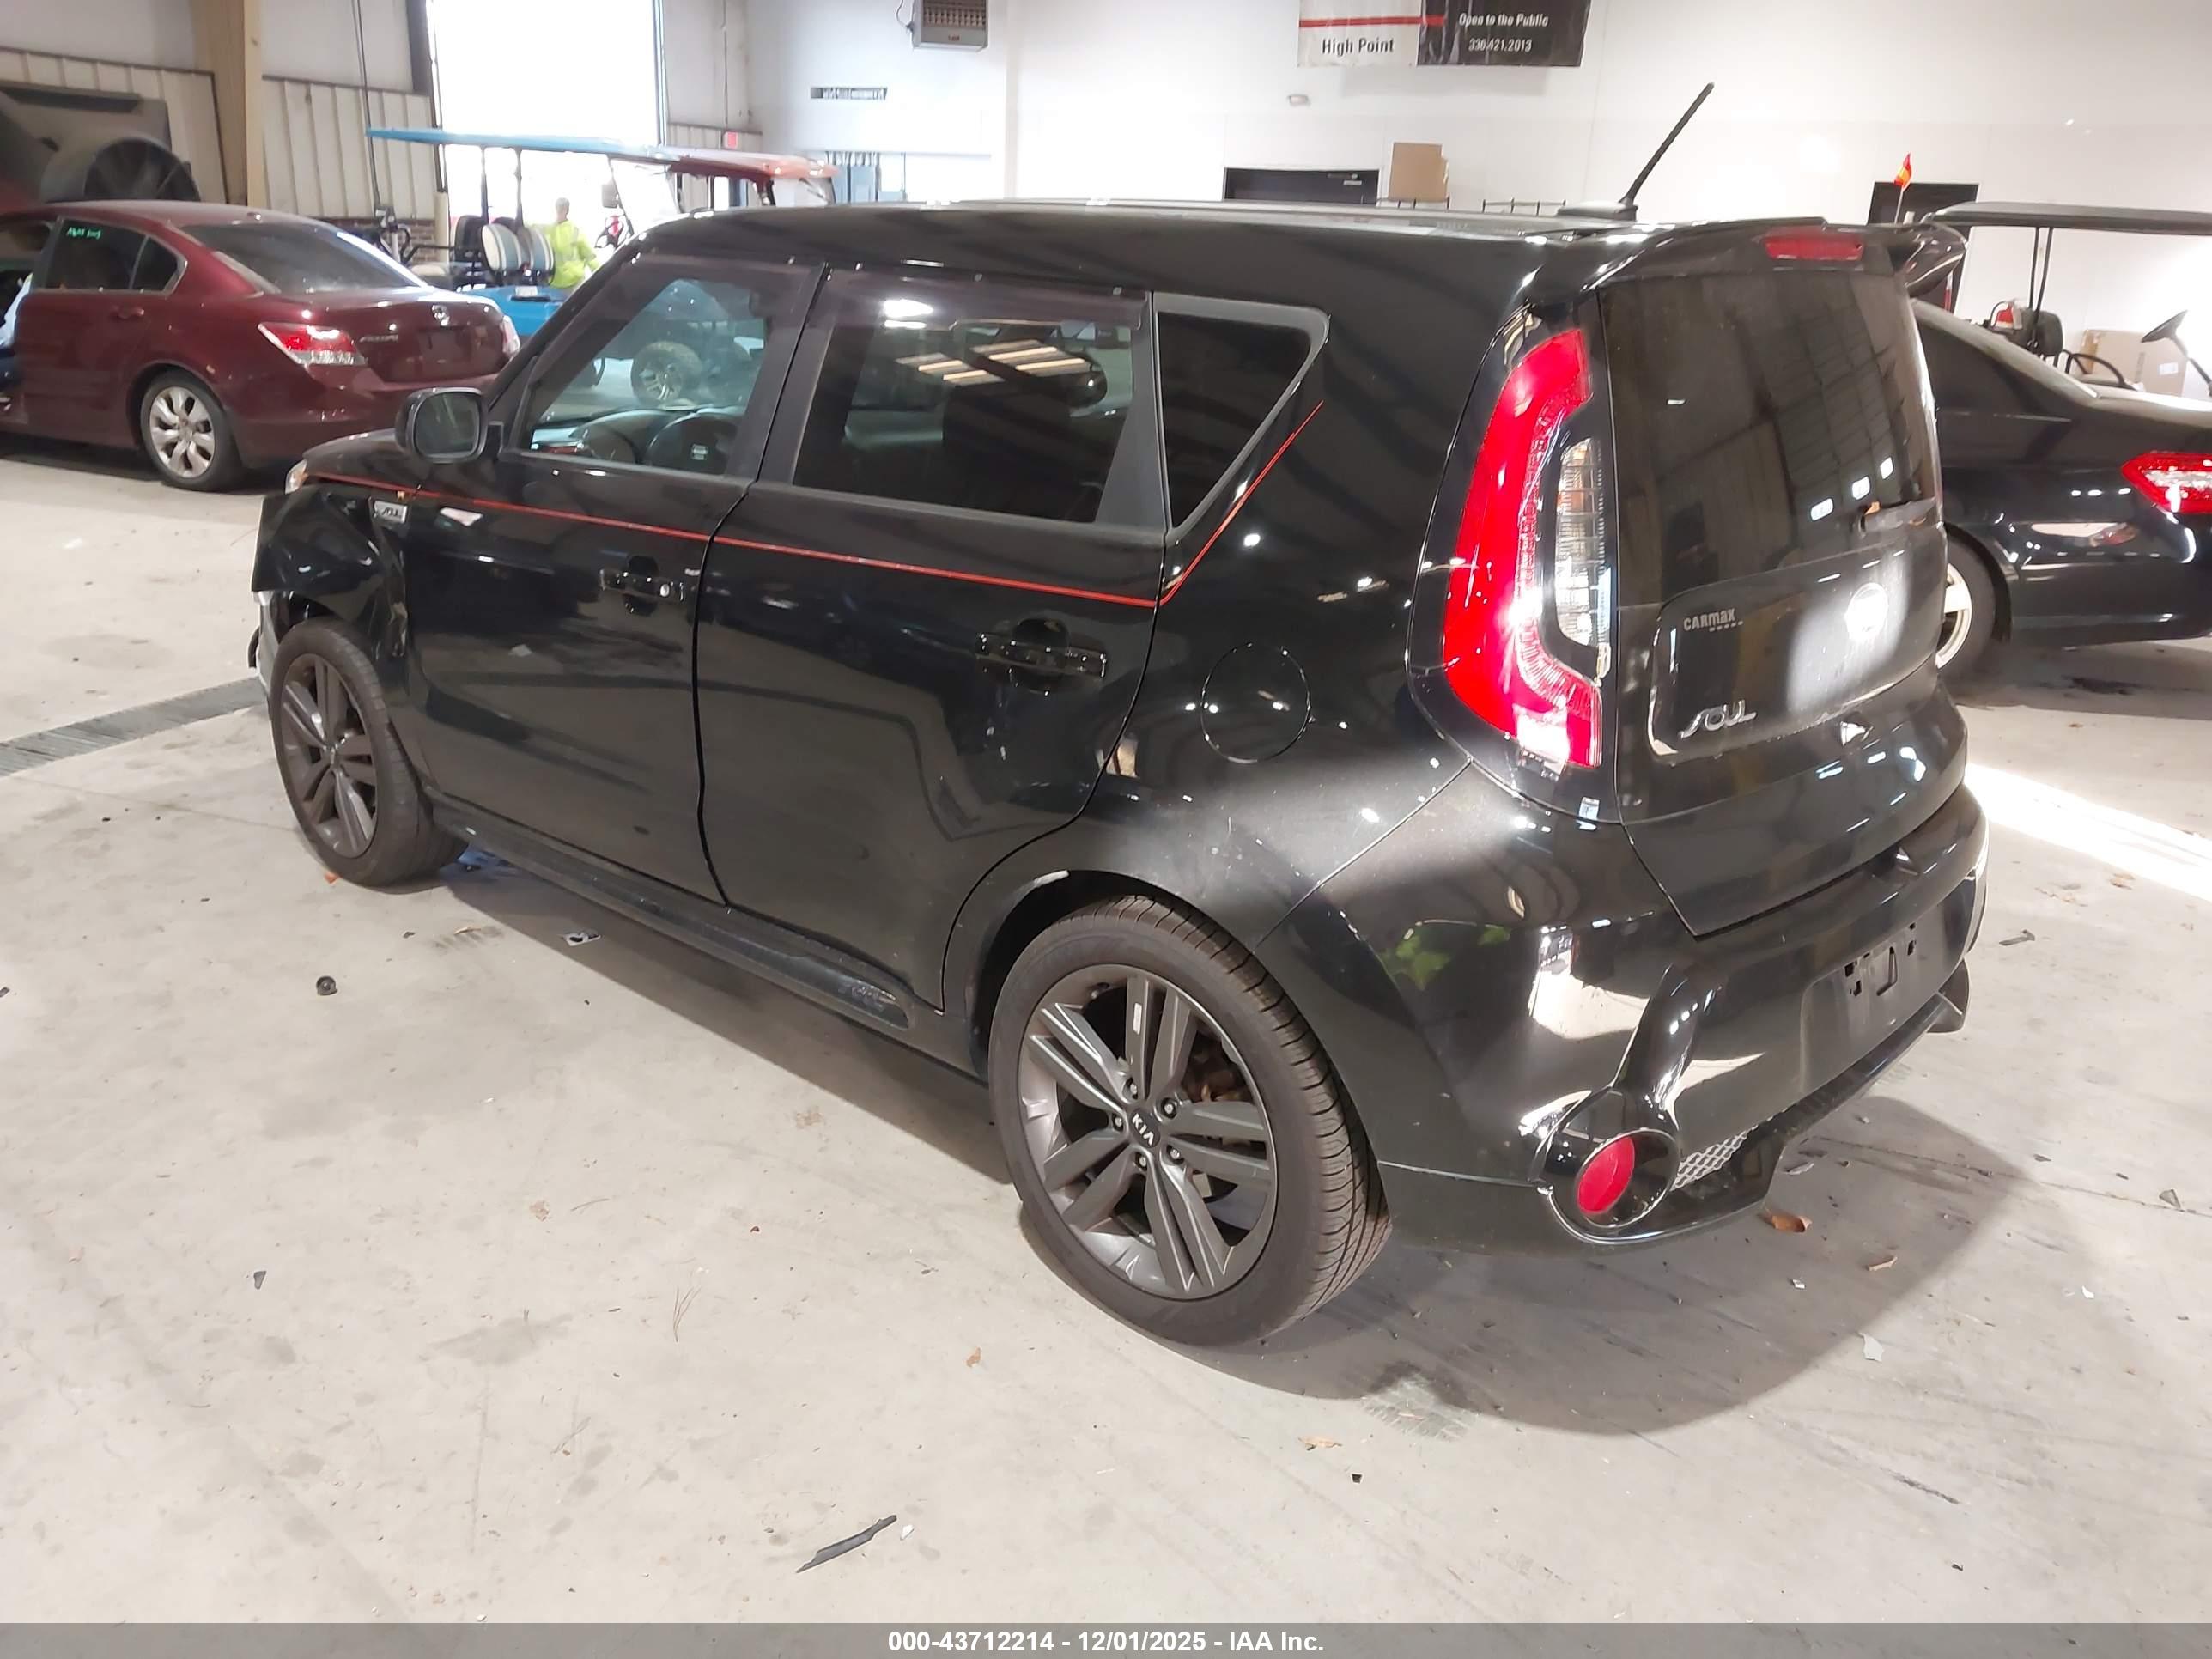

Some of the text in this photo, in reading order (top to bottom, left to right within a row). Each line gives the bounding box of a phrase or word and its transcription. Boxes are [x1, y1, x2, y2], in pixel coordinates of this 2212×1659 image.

[1459, 12, 1549, 28] Open to the Public
[1322, 37, 1395, 57] High Point
[1677, 699, 1757, 738] SOUL
[1132, 1113, 1154, 1146] KIA
